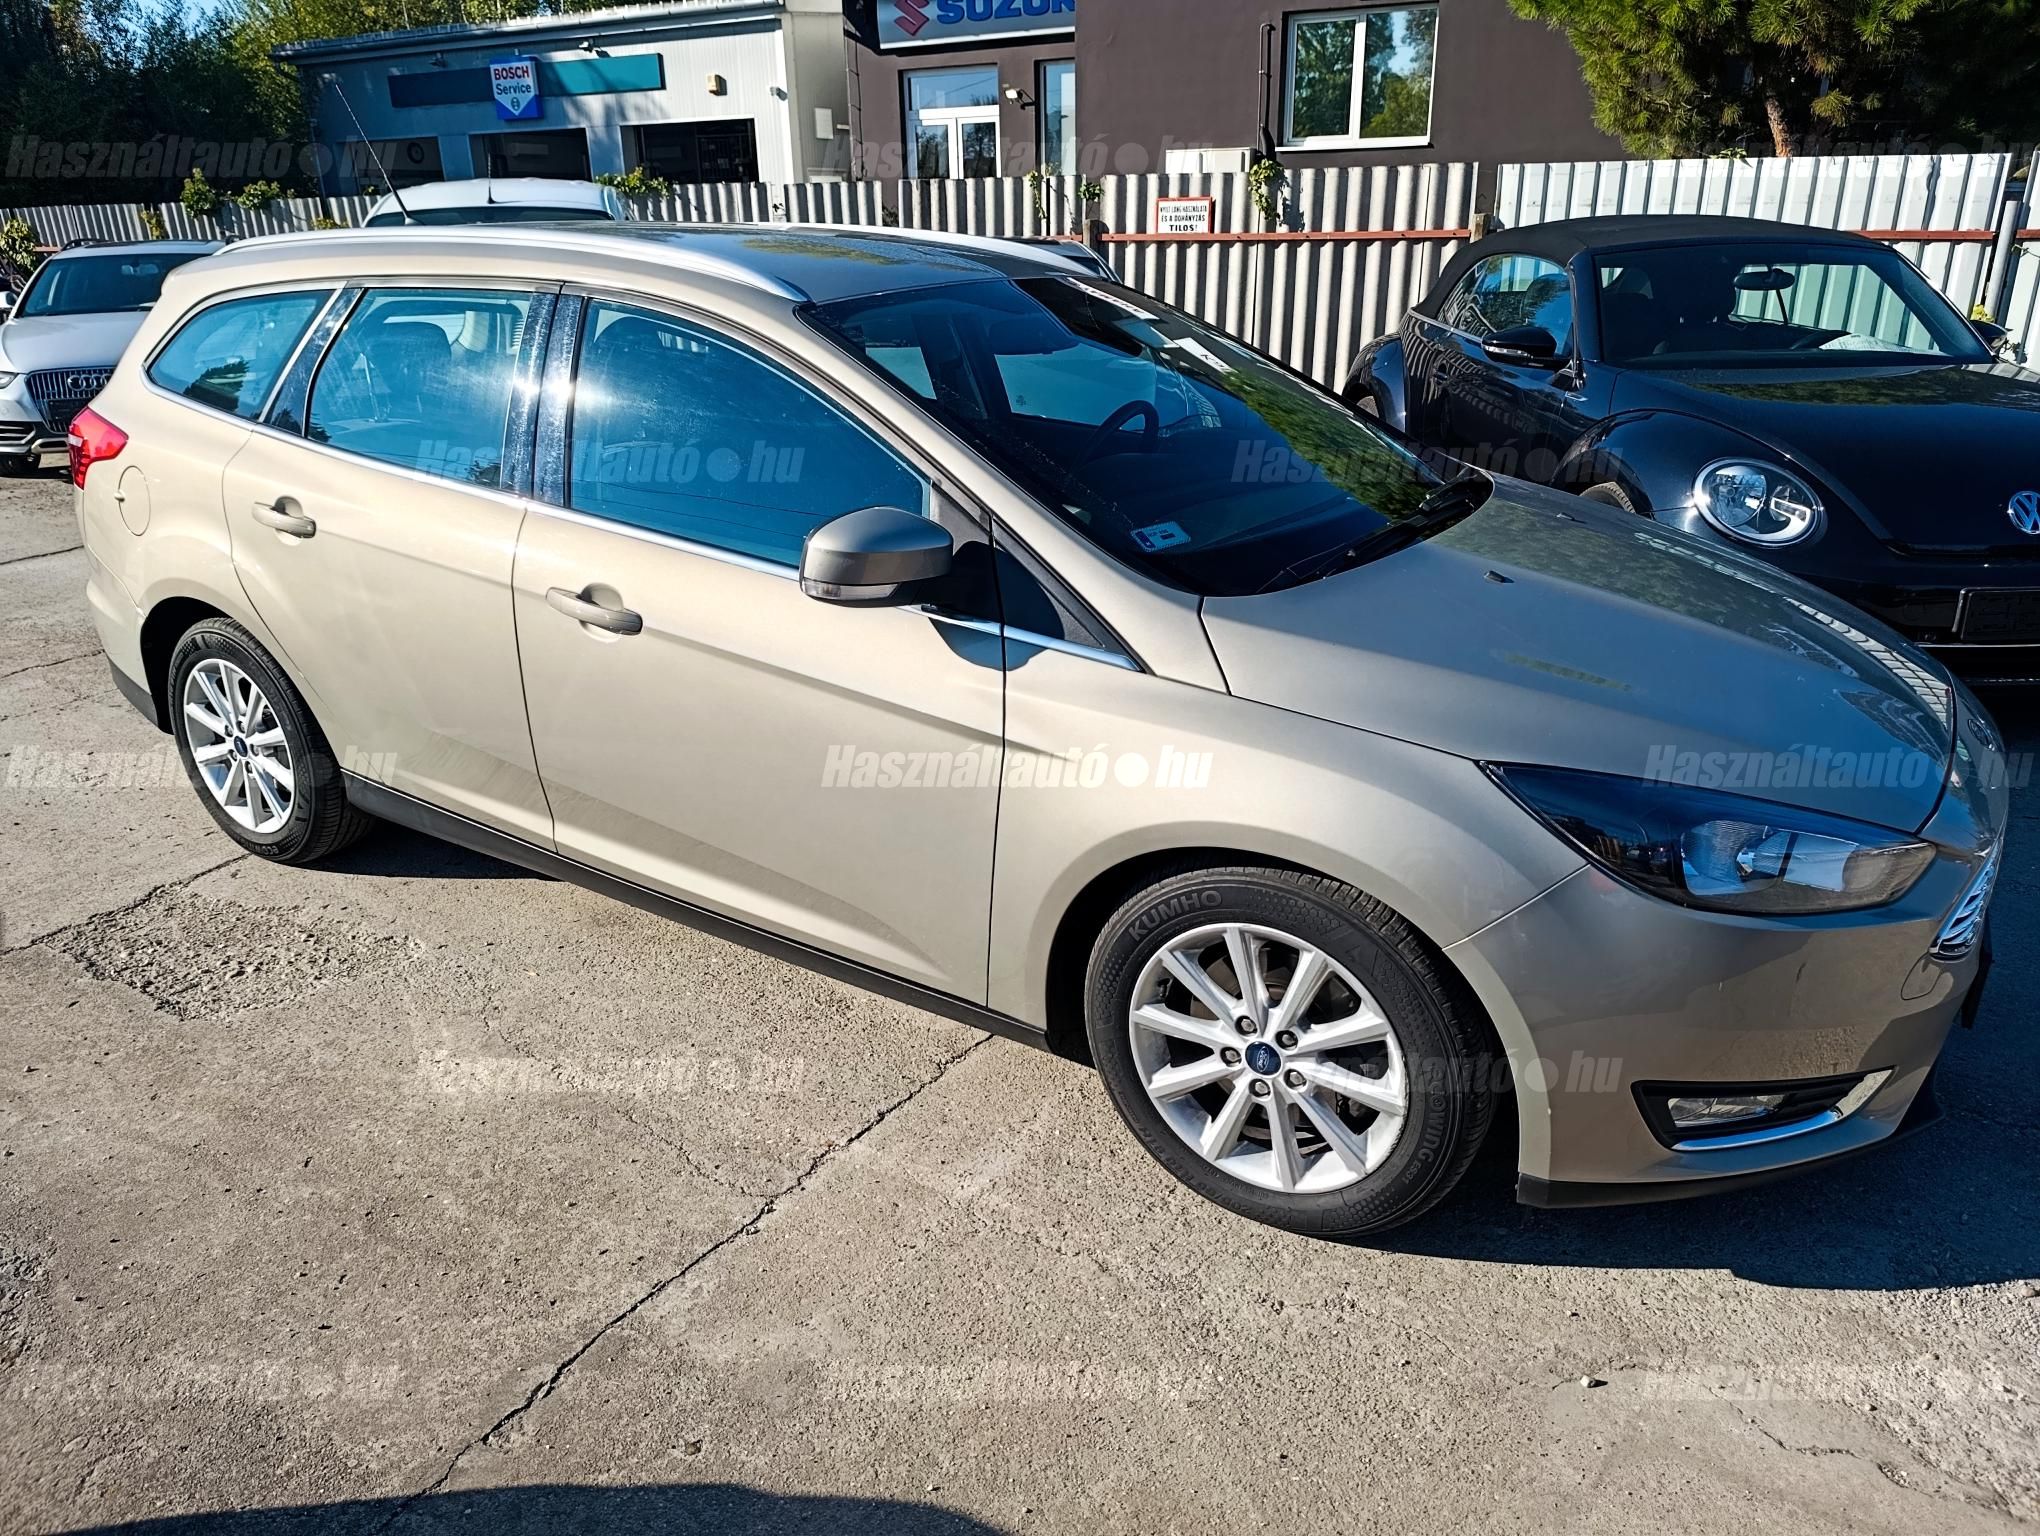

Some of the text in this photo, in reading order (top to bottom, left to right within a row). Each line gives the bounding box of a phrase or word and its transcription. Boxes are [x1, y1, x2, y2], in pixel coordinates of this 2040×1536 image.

[493, 65, 530, 80] BOSCH
[495, 82, 532, 95] Service
[1128, 890, 1222, 942] KUMHO
